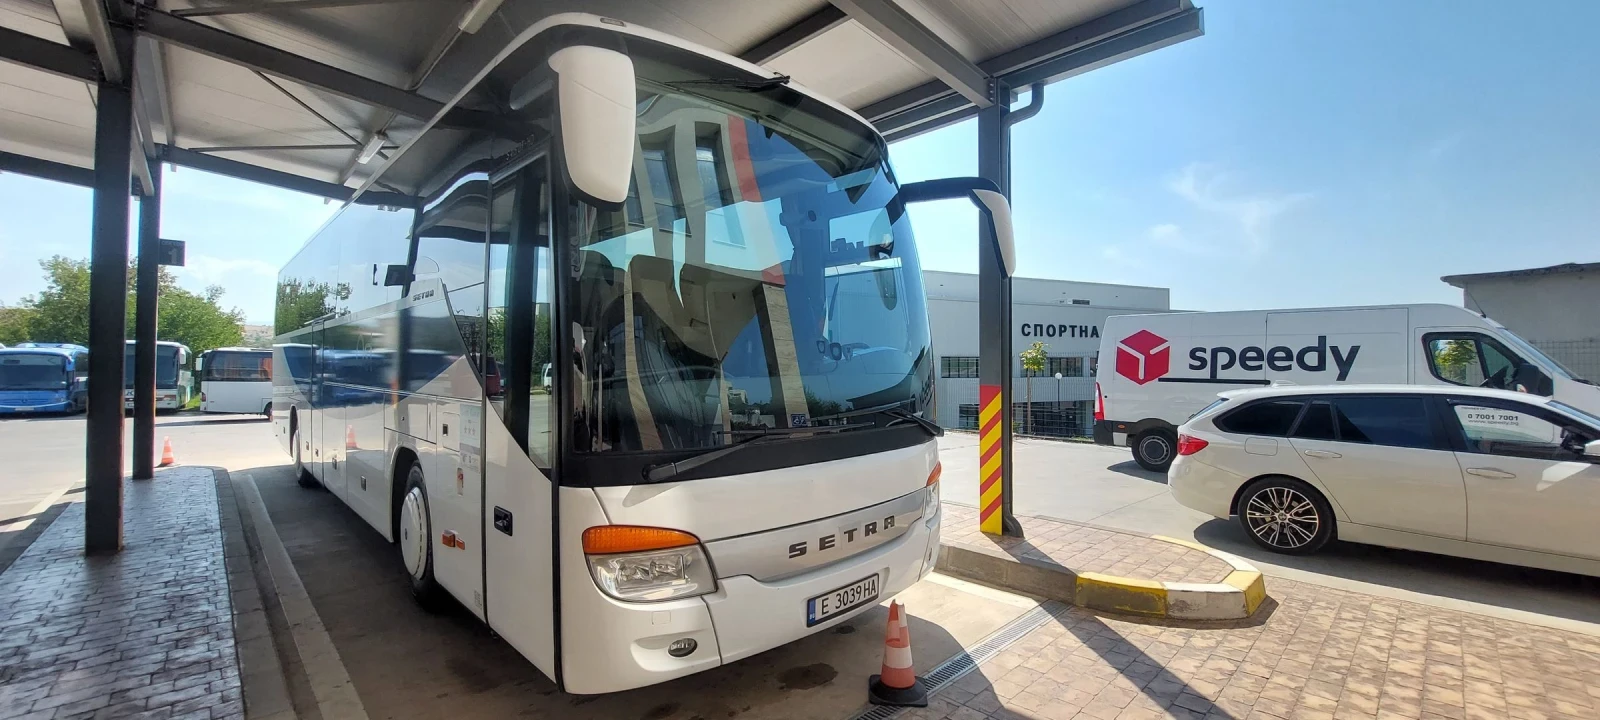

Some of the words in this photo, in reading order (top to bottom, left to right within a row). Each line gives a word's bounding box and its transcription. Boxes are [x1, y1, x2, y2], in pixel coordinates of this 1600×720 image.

[1021, 323, 1099, 338] СПОРТНА
[1188, 335, 1361, 381] speedy
[788, 515, 895, 558] SETRA
[821, 597, 829, 615] E
